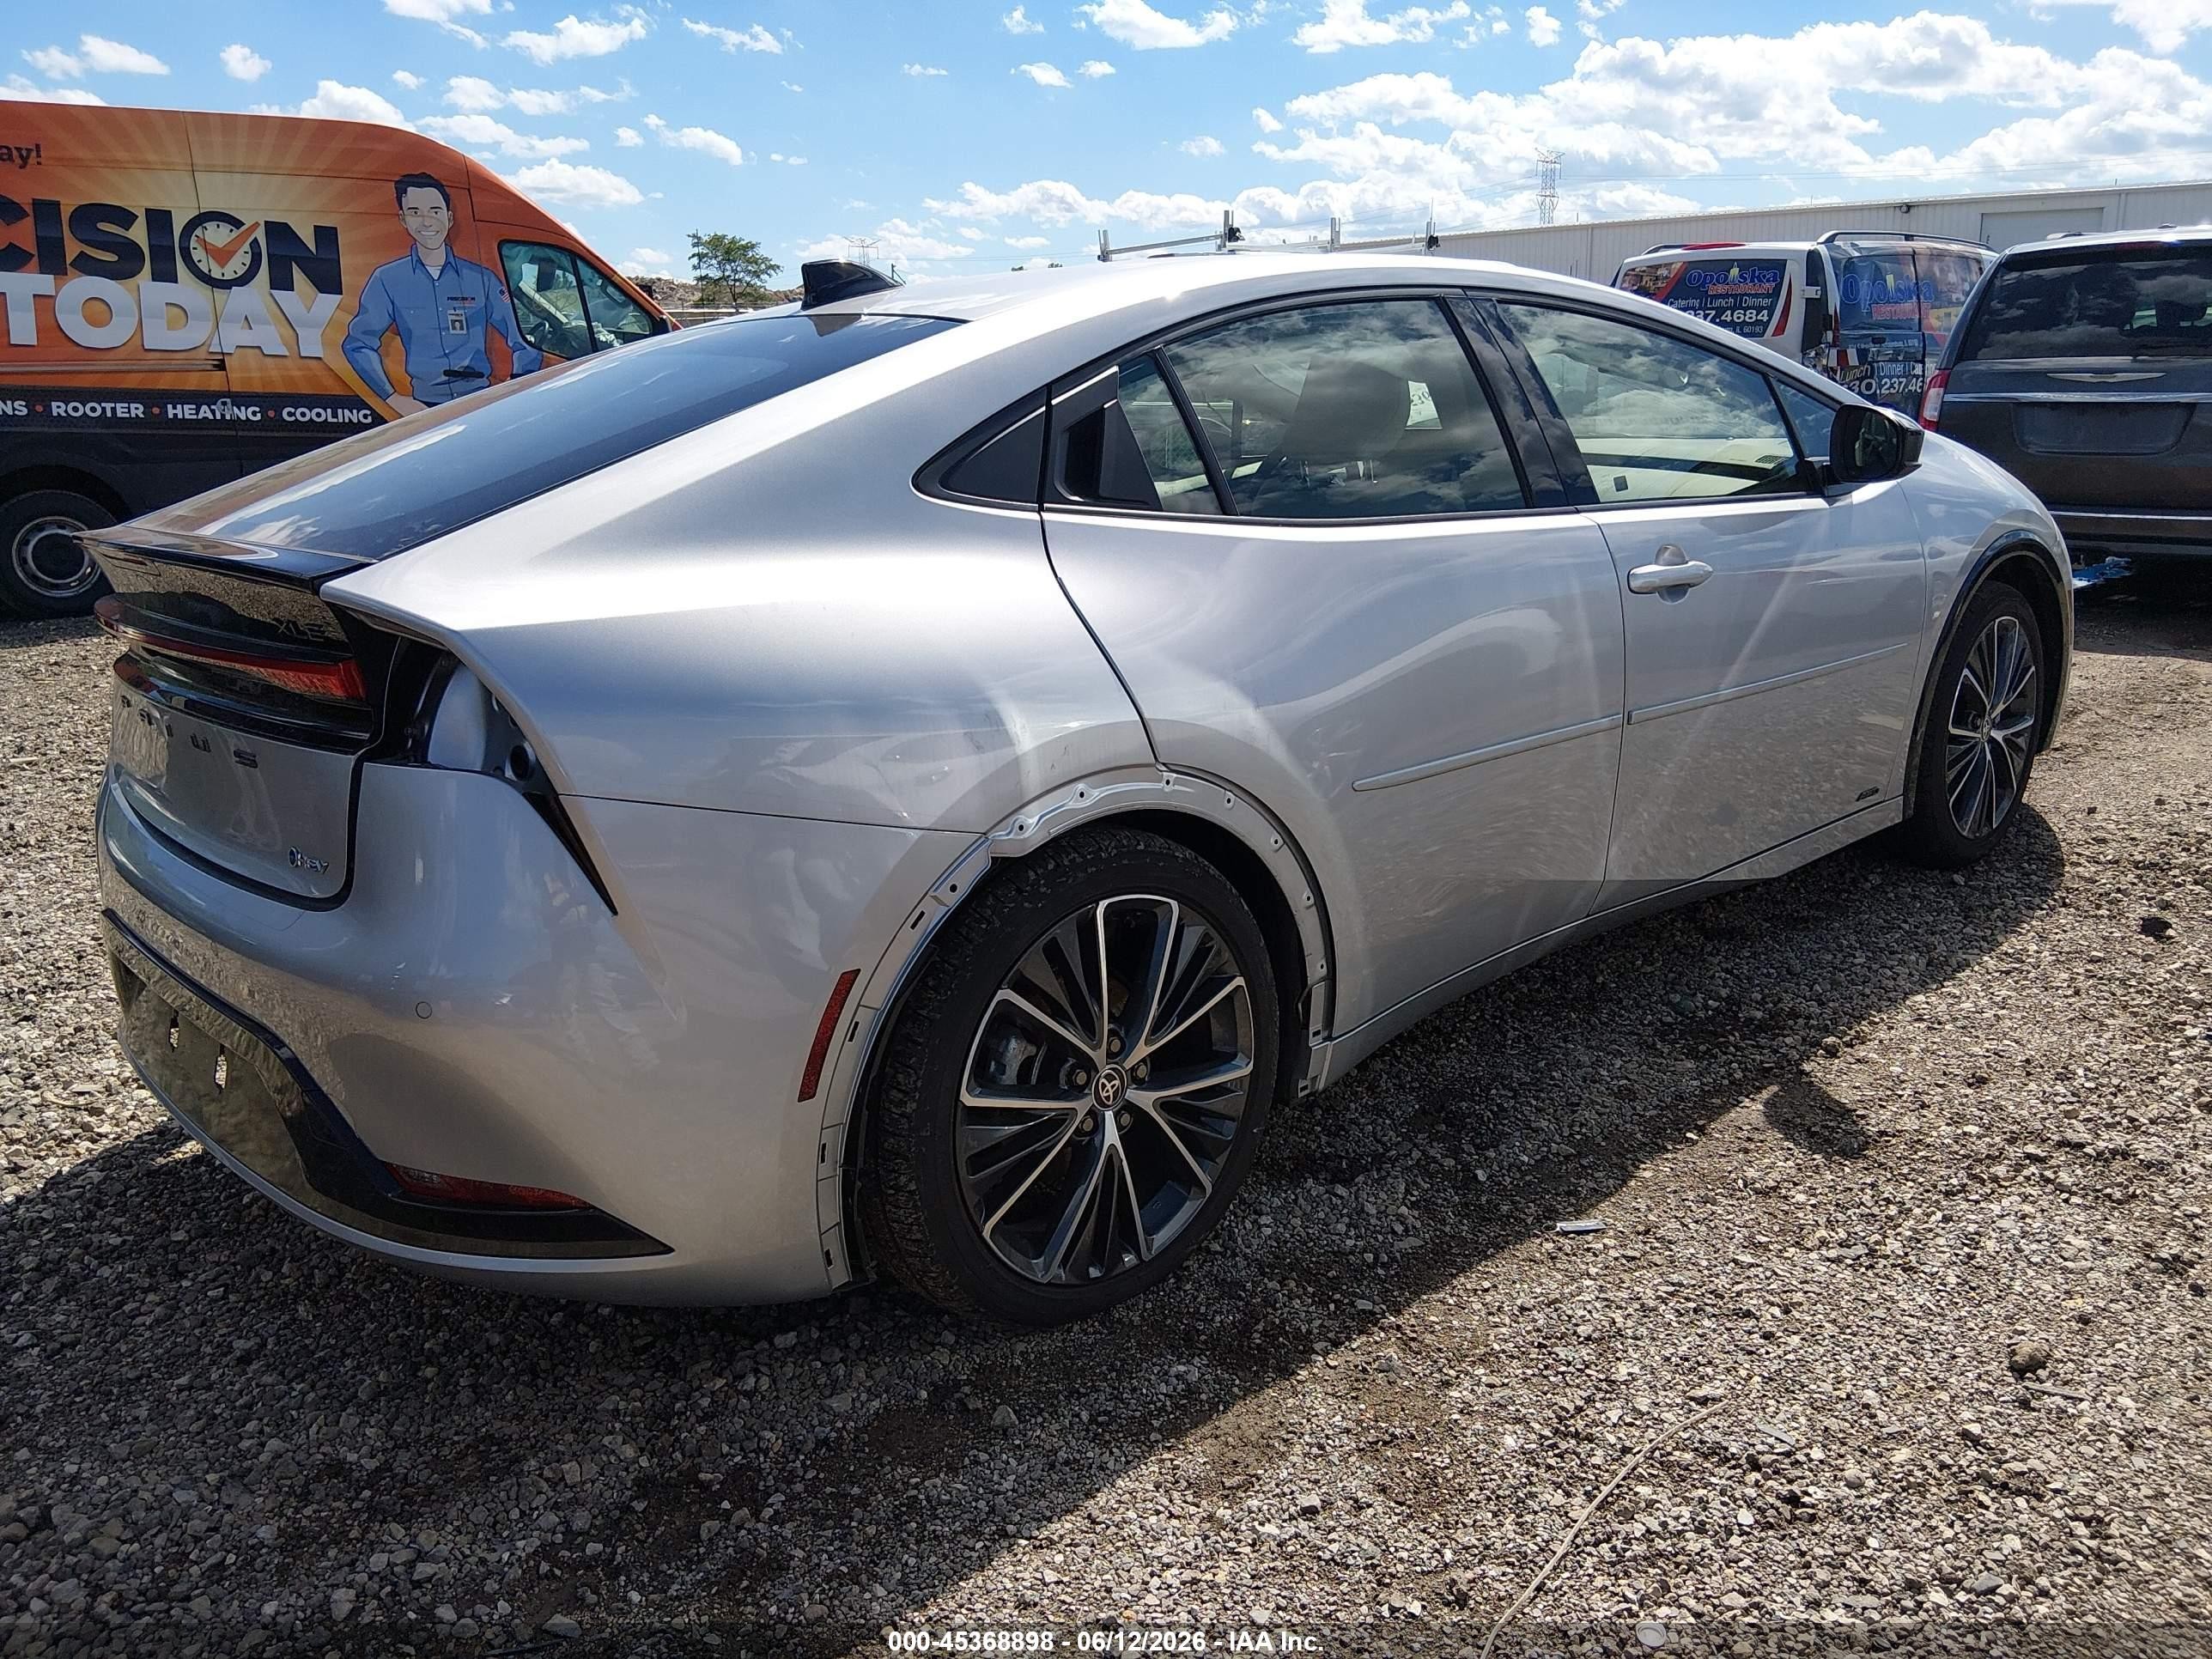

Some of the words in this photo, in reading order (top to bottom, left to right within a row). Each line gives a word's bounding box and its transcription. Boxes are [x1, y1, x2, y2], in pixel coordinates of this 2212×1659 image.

[1708, 284, 1775, 295] RESTAURANT
[1668, 297, 1700, 309] Catering
[1707, 297, 1734, 307] Lunch
[1742, 296, 1772, 307] Dinner
[0, 271, 343, 358] TODAY
[1880, 362, 1904, 376] Dinner
[52, 401, 145, 418] ROOTER
[167, 404, 262, 421] HEATING
[282, 406, 373, 423] COOLING
